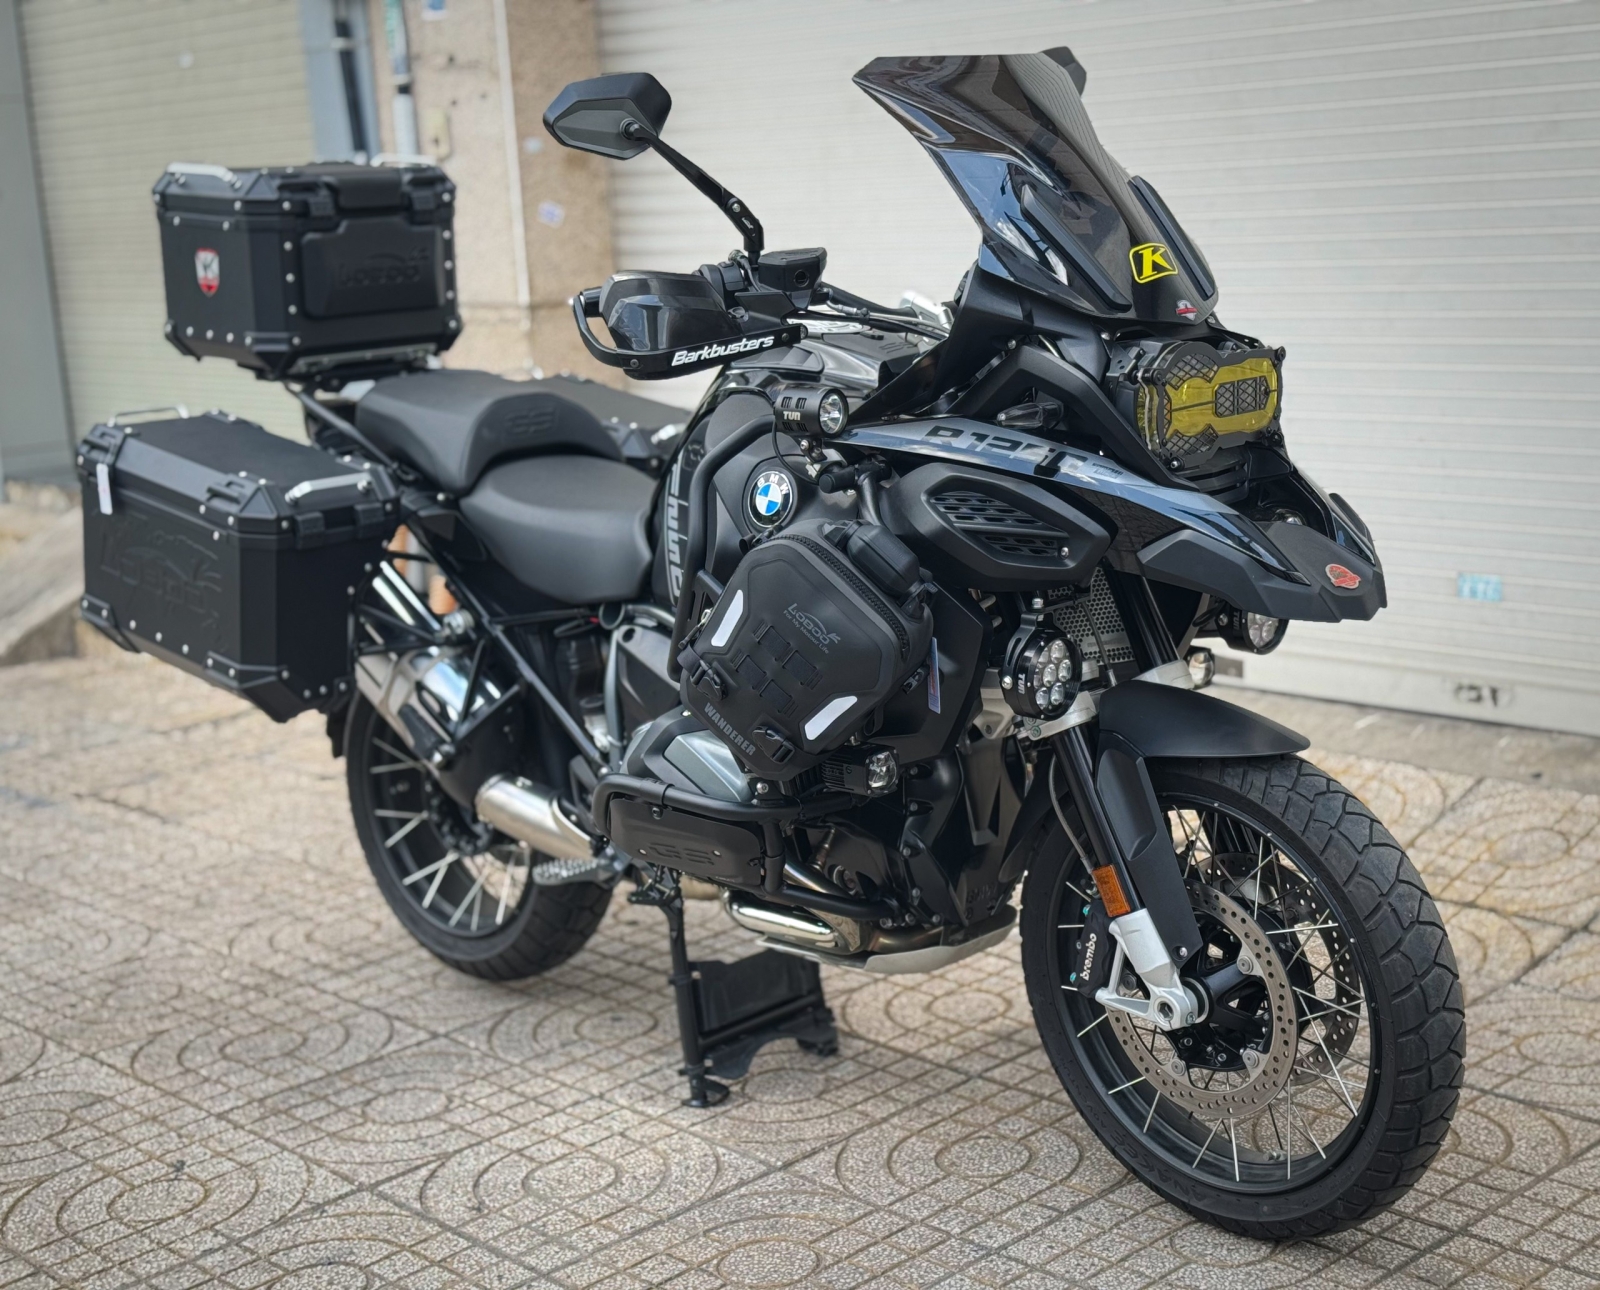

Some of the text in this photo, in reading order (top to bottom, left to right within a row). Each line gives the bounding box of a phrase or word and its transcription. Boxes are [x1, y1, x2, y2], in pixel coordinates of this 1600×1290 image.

[1138, 246, 1174, 280] K
[671, 336, 775, 367] Barkbusters
[757, 473, 789, 495] BMW
[783, 610, 829, 654] For My Motour Life
[787, 603, 830, 645] LOBOO
[704, 702, 756, 756] WANDERER
[1080, 933, 1097, 981] brembo
